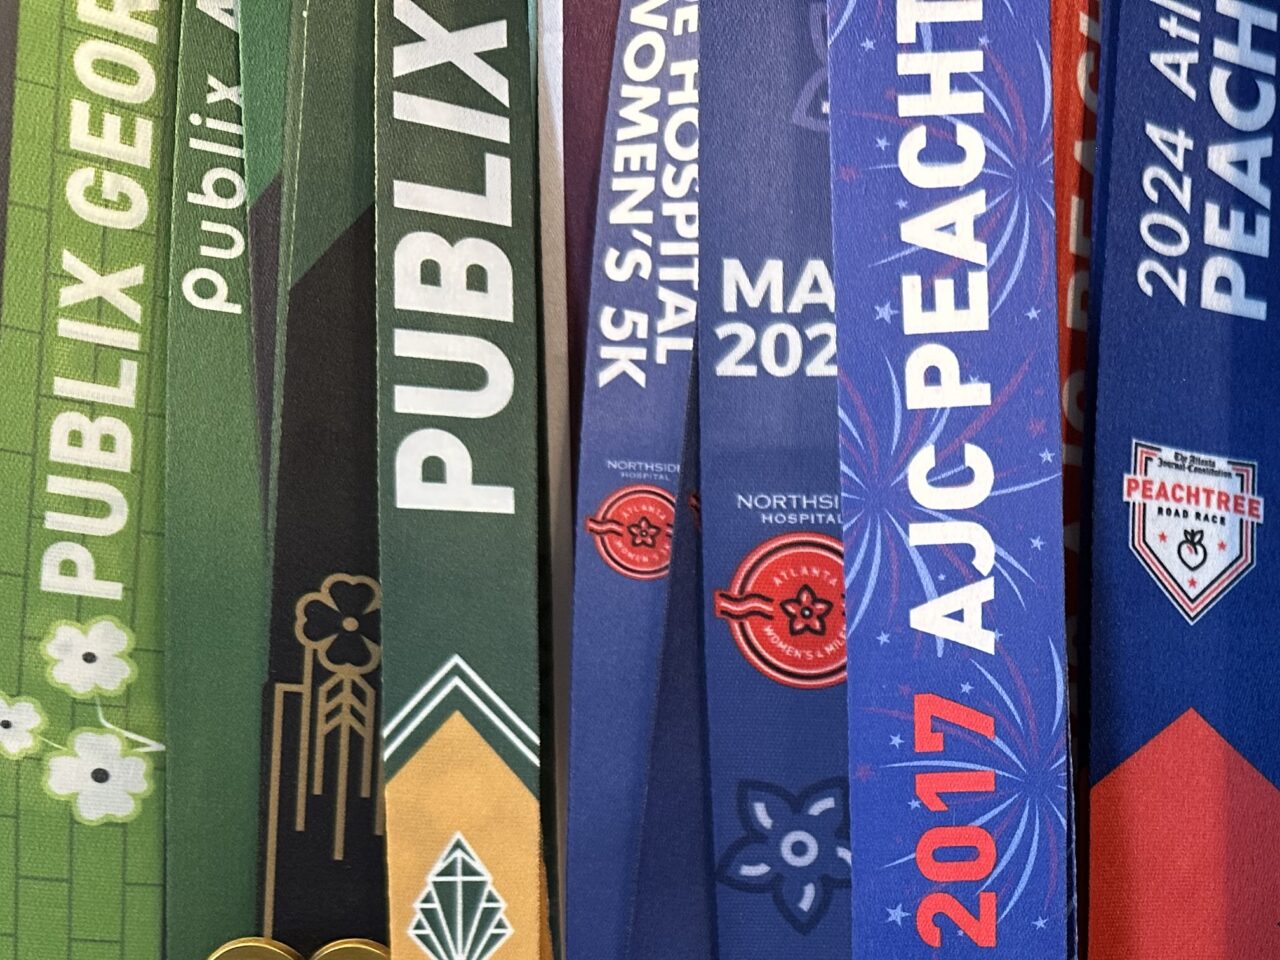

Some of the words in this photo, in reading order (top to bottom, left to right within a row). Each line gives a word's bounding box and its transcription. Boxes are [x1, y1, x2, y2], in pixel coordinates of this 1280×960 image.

[392, 0, 516, 514] PUBLIX
[655, 59, 699, 365] HOSPITAL
[896, 0, 993, 409] PEACHT
[1137, 122, 1194, 306] 2024
[1200, 0, 1278, 321] PEACH
[40, 249, 148, 600] PUBLIX
[599, 306, 648, 388] 5K
[772, 566, 838, 586] ATLANTA
[908, 444, 998, 655] AJC
[1126, 478, 1261, 519] PEACHTREE
[1157, 506, 1189, 519] ROAD
[1195, 512, 1226, 526] RACE
[914, 693, 997, 948] 2017
